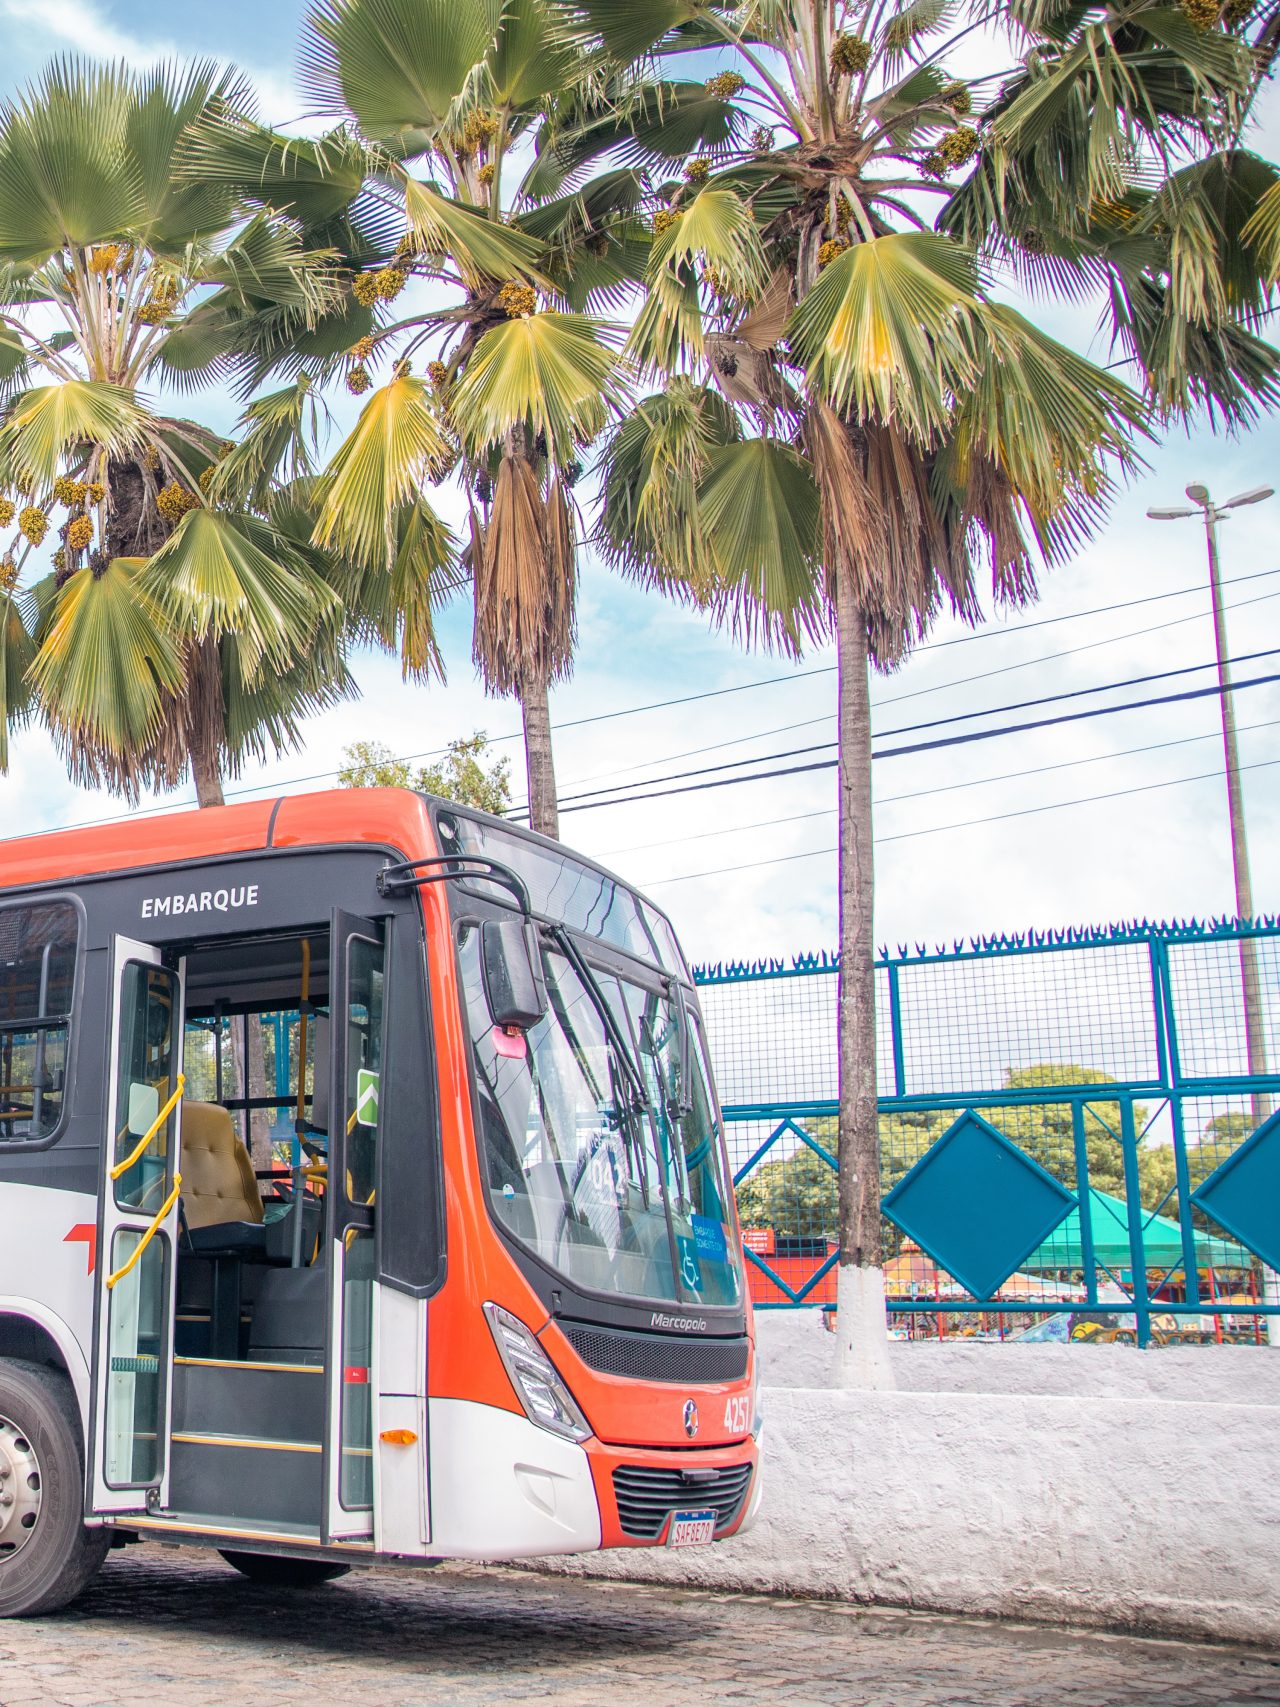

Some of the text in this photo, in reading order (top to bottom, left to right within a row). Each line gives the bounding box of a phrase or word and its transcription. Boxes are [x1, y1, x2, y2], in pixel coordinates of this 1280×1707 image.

[141, 884, 259, 919] EMBARQUE
[650, 1312, 707, 1332] Marcopolo
[723, 1396, 750, 1434] 4257
[675, 1522, 710, 1543] SAF8E79
